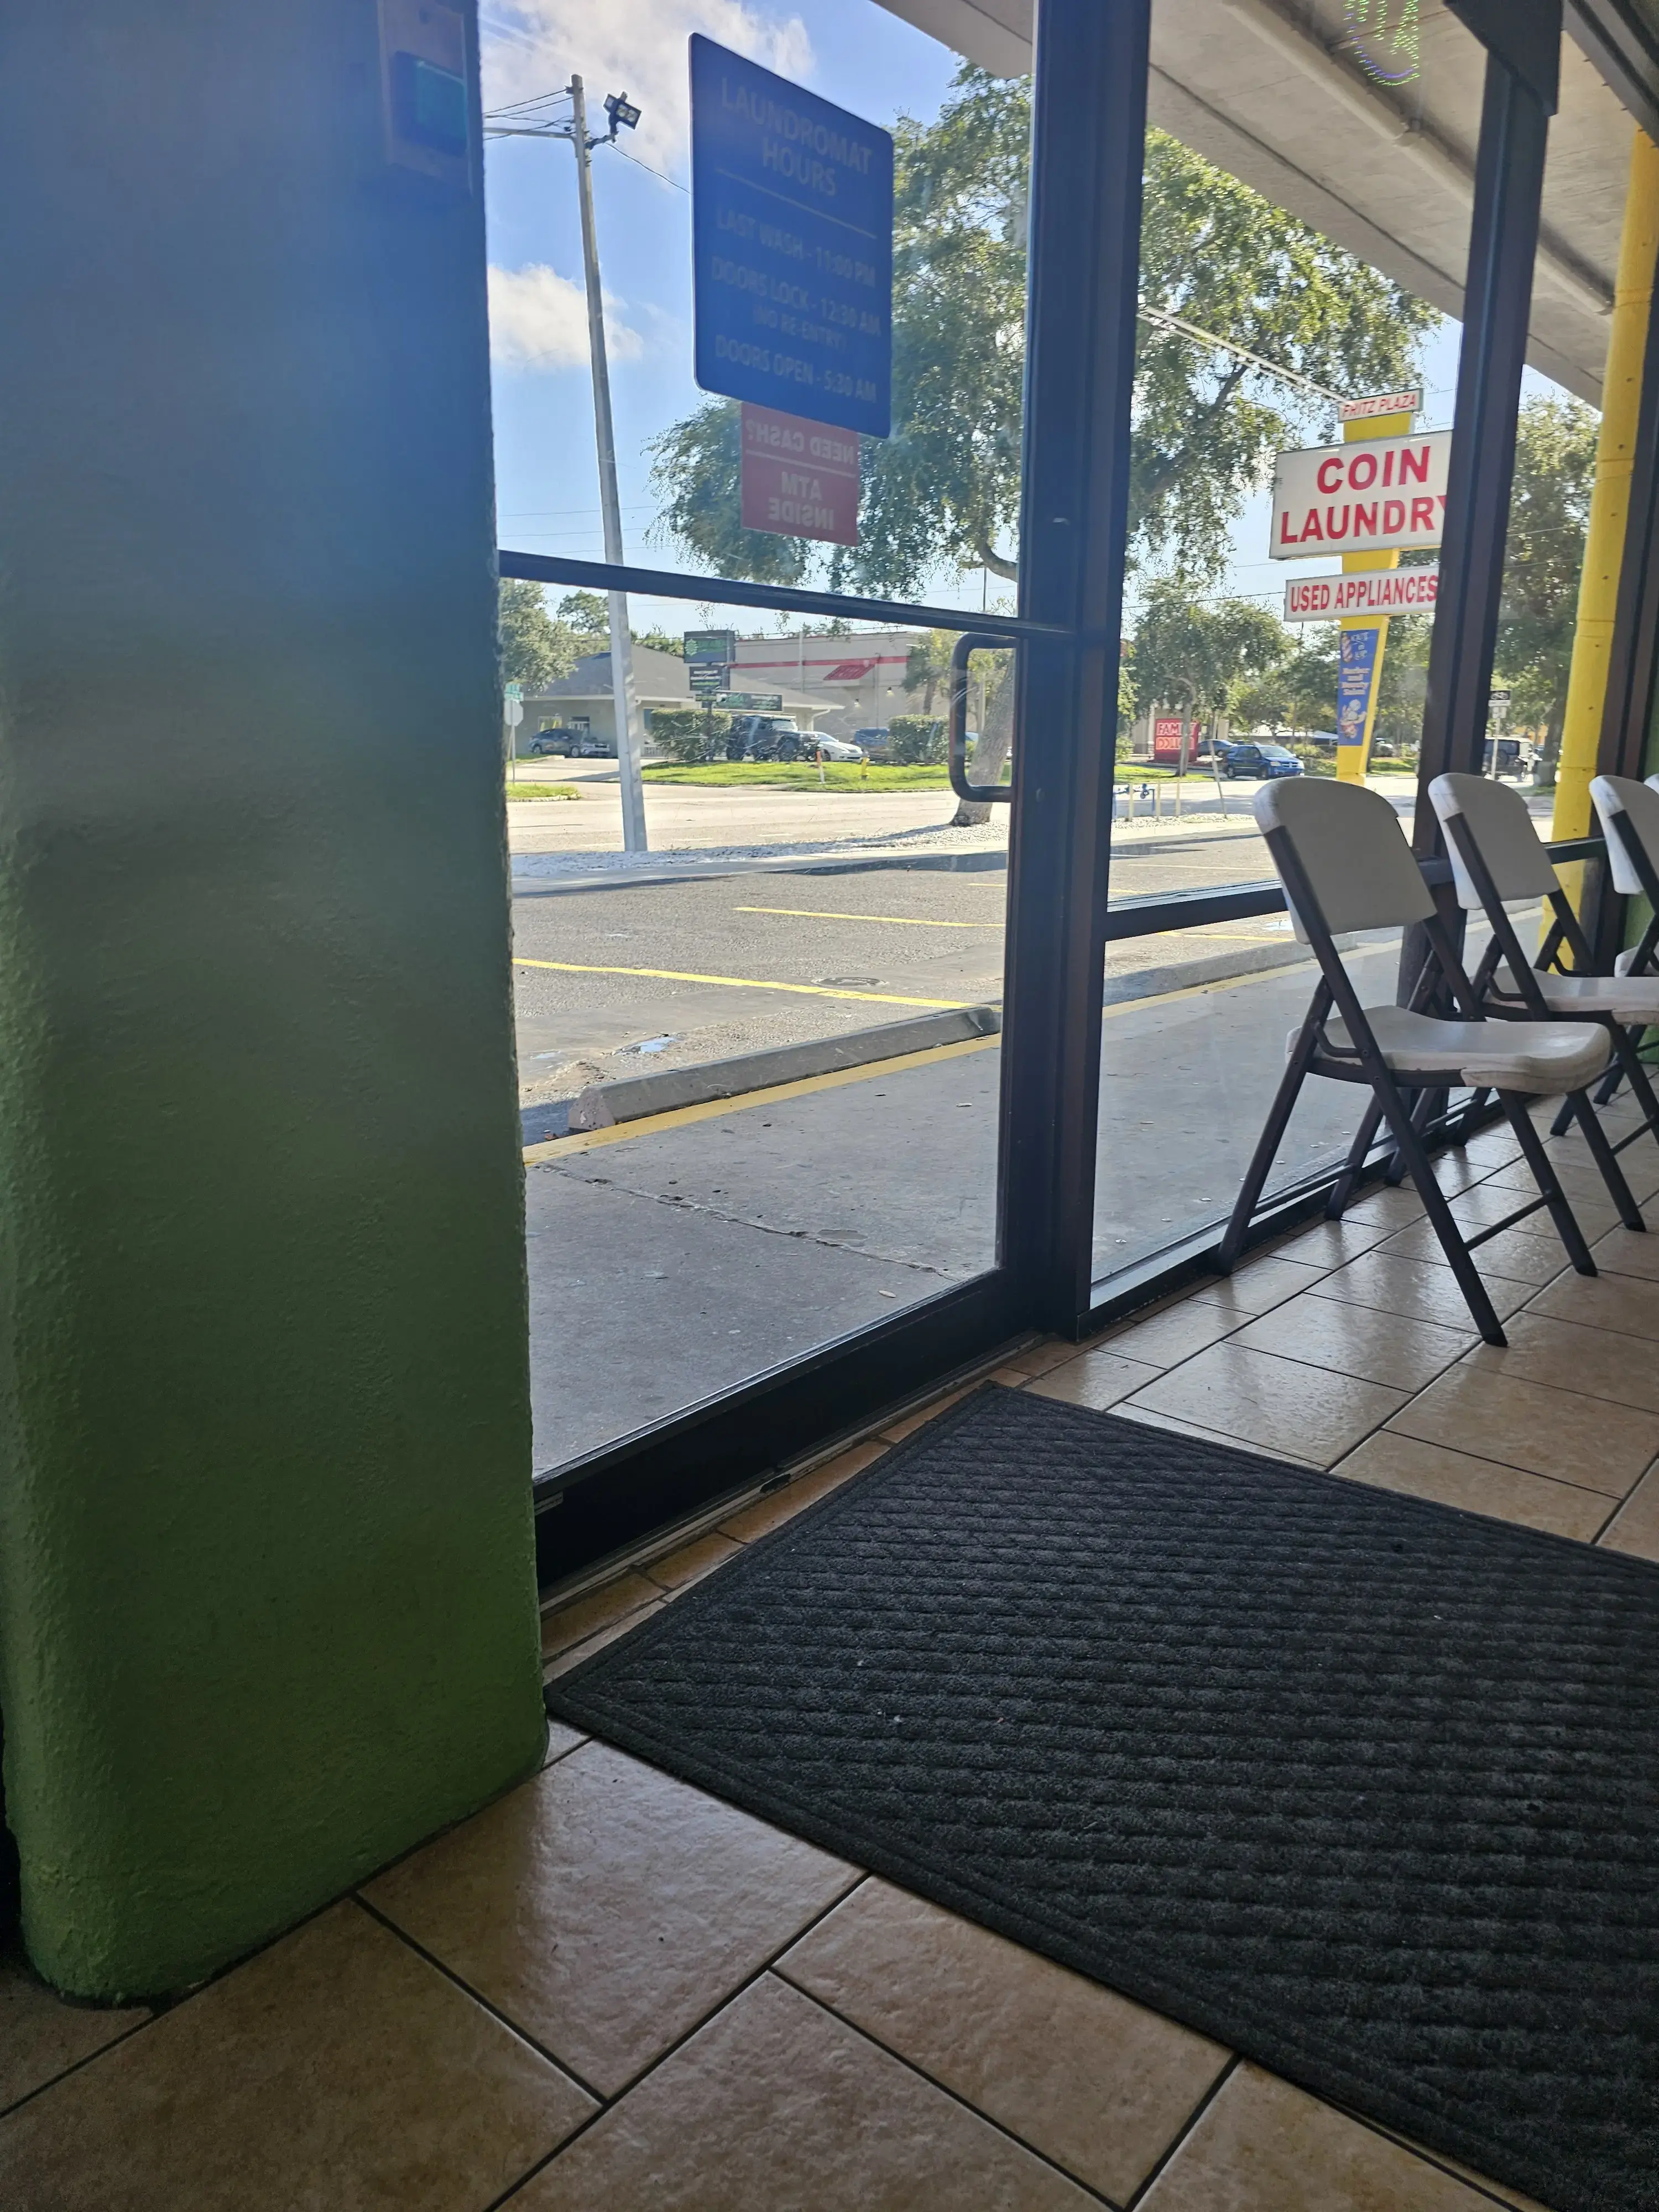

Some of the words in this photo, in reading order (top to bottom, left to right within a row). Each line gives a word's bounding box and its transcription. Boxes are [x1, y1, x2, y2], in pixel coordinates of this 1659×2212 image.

[721, 76, 873, 175] LAUNDROMAT
[762, 137, 836, 196] HOURS
[717, 207, 756, 240] LAST
[759, 223, 803, 259] WASH
[855, 262, 876, 288] PM
[711, 255, 767, 296] DOORS
[771, 278, 809, 311] LOCK
[859, 311, 881, 337] AM
[715, 335, 769, 372] DOORS
[773, 352, 813, 385] OPEN
[855, 379, 877, 404] AM
[1378, 394, 1417, 413] PLAZA
[1317, 446, 1431, 494] COIN
[1291, 583, 1329, 612] USED
[1334, 575, 1438, 609] APPLIANCES
[1156, 722, 1198, 735] FAMIY
